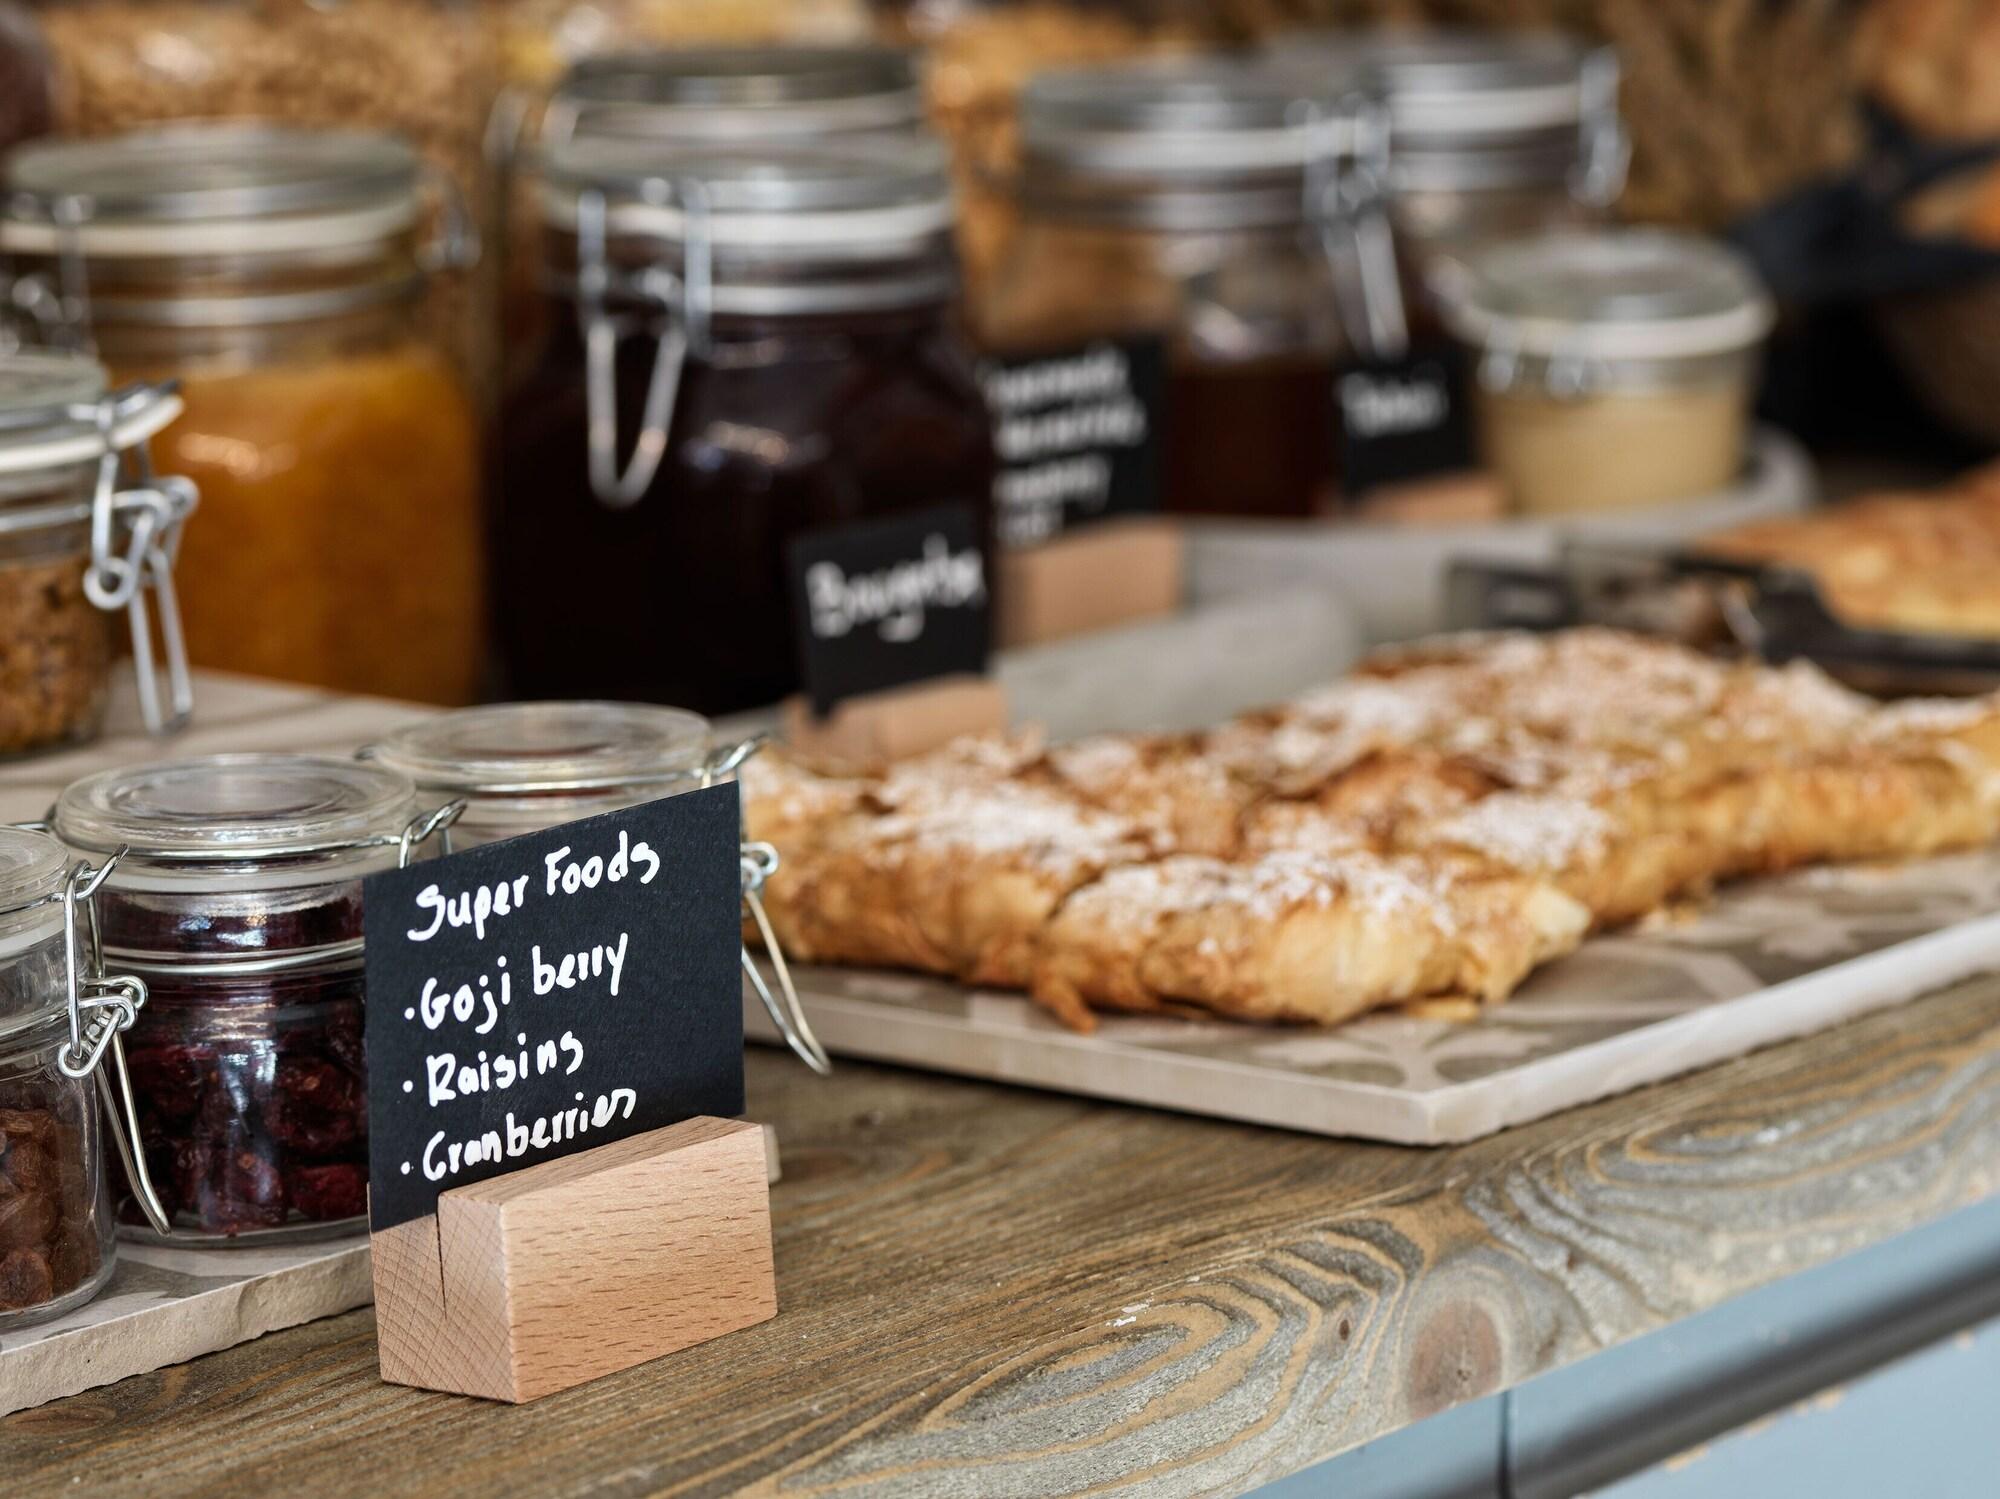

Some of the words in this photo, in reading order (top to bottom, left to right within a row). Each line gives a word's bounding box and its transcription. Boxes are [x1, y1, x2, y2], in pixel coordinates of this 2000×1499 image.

[406, 874, 530, 942] Super
[544, 829, 661, 896] Foods
[531, 932, 629, 997] berry
[425, 1030, 584, 1107] Raisins
